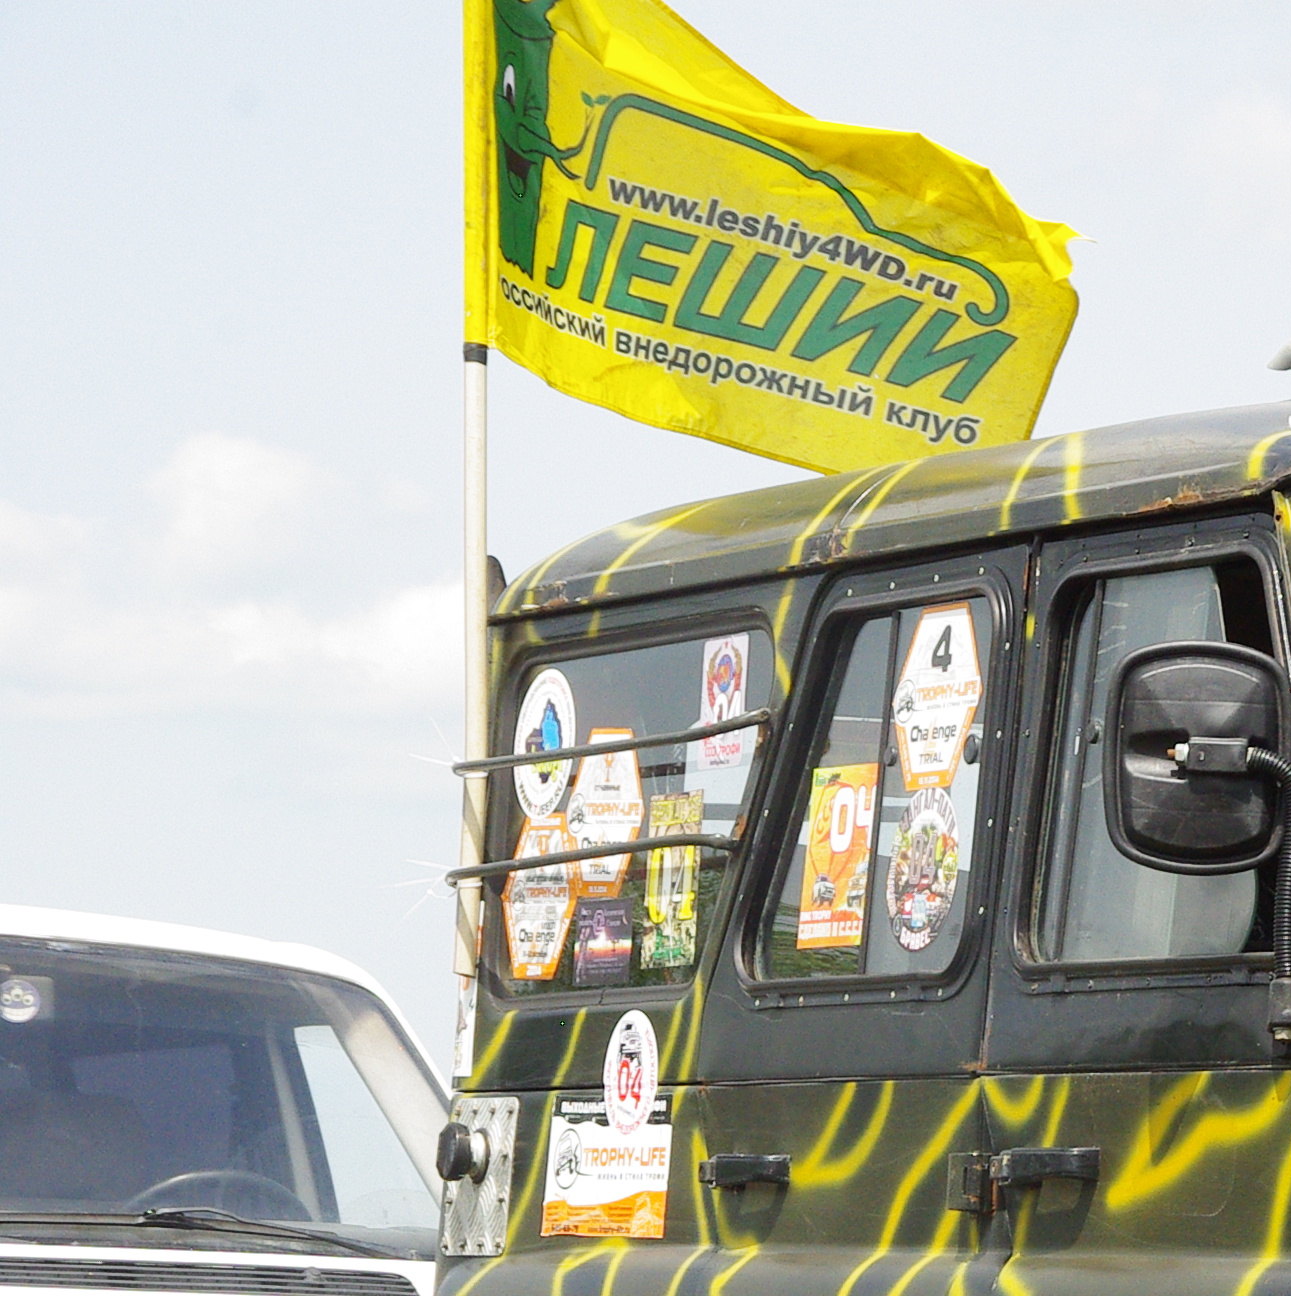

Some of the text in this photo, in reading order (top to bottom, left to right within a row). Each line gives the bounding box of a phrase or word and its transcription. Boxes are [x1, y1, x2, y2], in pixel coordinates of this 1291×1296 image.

[607, 176, 959, 301] www.leshiy4WD.ru
[546, 199, 1018, 403] ЛЕШИЙ
[500, 276, 981, 445] оссийский внедорожный клуб
[932, 624, 953, 673] 4
[916, 680, 978, 702] TROPHY-LIFE
[919, 752, 943, 765] TRIAL
[585, 803, 640, 816] TROPHY-LIFE
[617, 1060, 642, 1110] 04
[583, 1147, 666, 1167] TROPHY-LIFE
